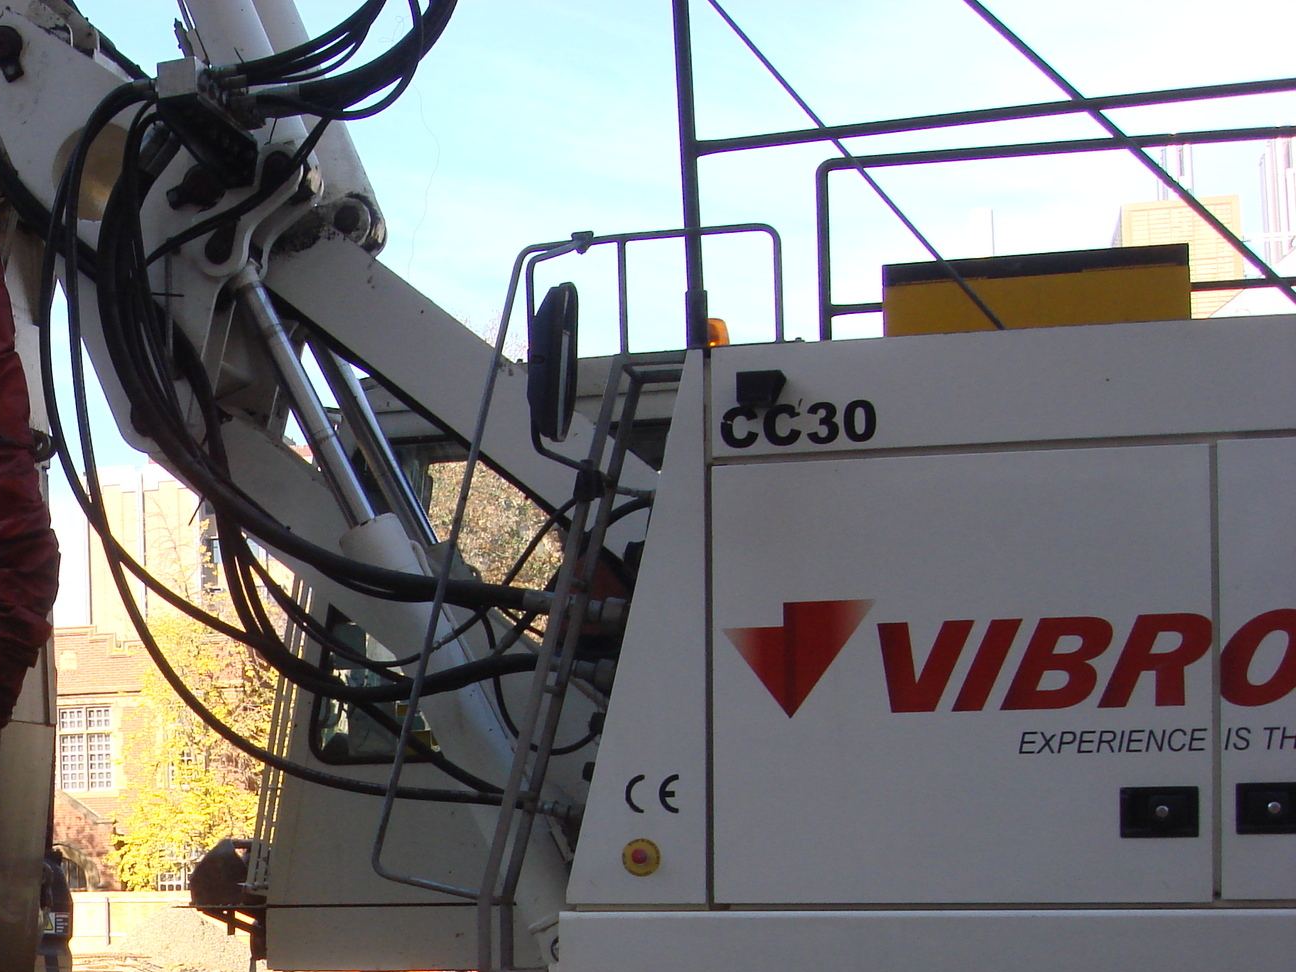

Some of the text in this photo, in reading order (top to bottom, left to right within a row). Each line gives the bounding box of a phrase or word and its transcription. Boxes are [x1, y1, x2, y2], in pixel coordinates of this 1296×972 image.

[721, 399, 877, 449] CC30
[877, 609, 1296, 713] VIBRO
[1018, 728, 1208, 755] EXPERIENCE
[1224, 727, 1252, 751] IS
[625, 774, 680, 814] CE
